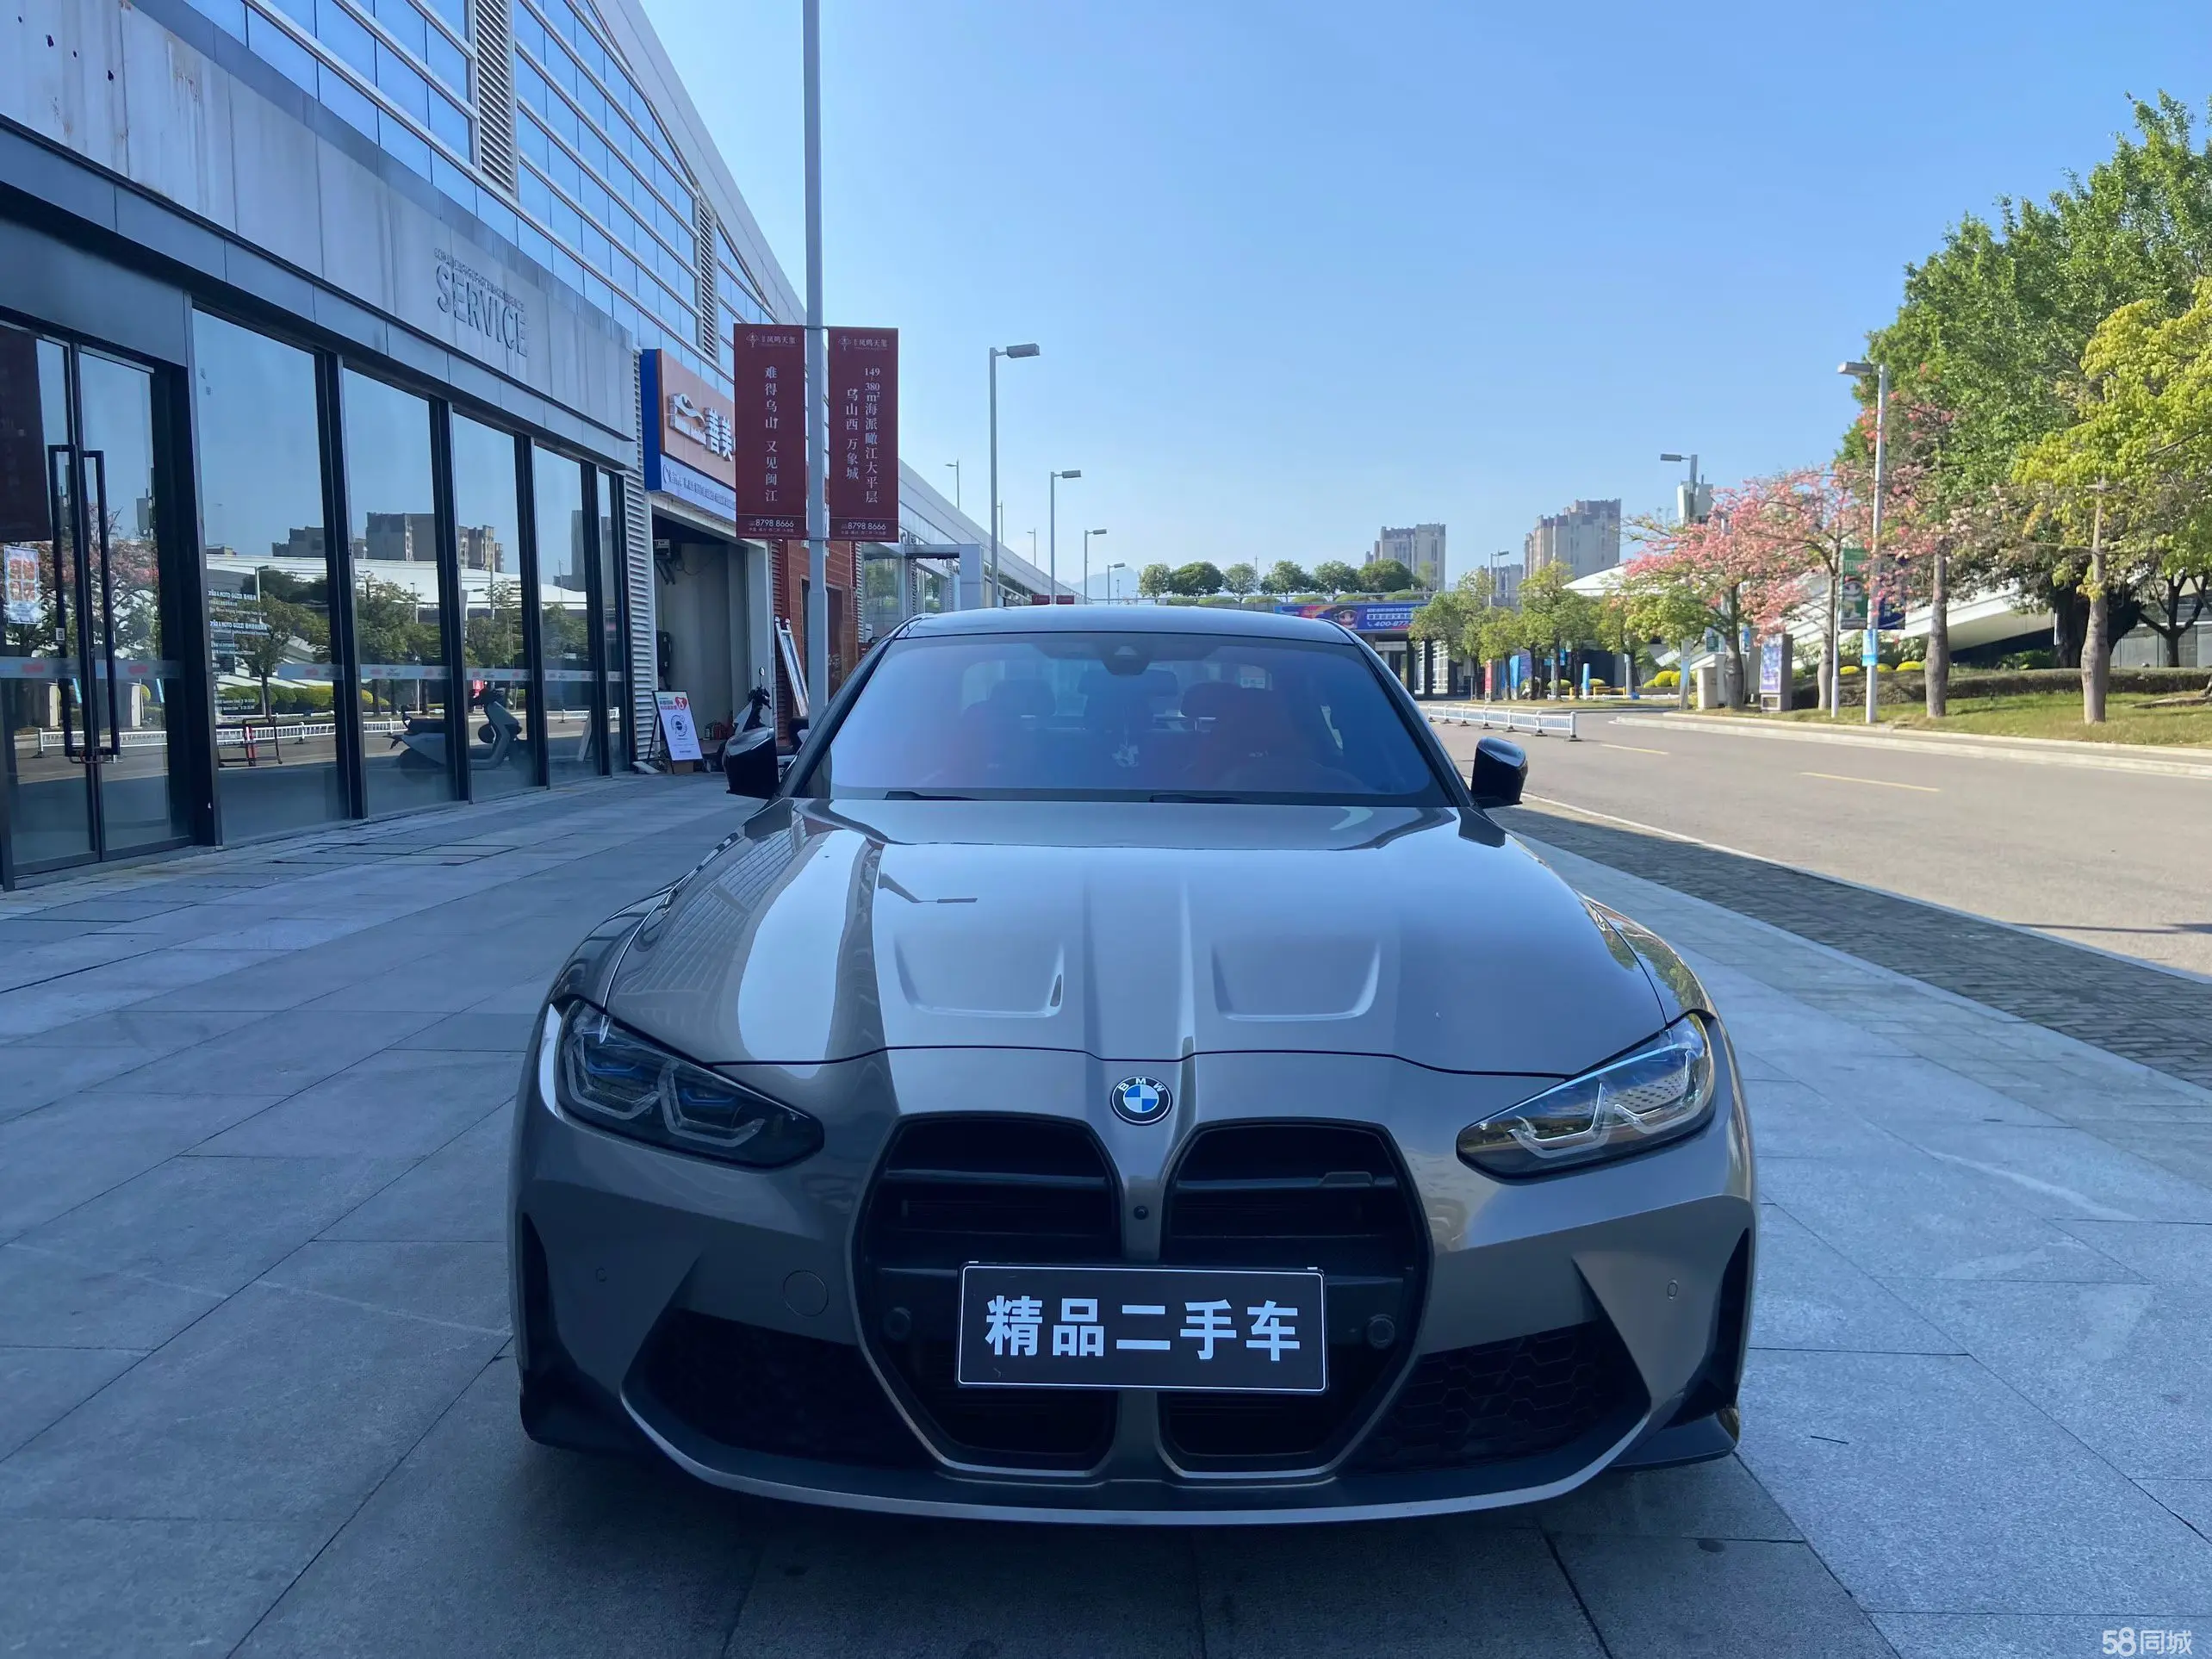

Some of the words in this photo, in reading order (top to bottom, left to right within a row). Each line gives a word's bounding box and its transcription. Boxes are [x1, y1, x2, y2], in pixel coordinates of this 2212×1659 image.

[436, 264, 528, 357] SERVICE
[865, 368, 880, 376] 149
[865, 382, 880, 391] 380
[765, 366, 779, 429] 难得乌山
[765, 440, 778, 502] 又见闽江
[846, 438, 859, 480] 万象城
[755, 519, 774, 527] 8798
[776, 519, 794, 528] 8666
[1118, 1078, 1165, 1092] BMW
[985, 1295, 1301, 1362] 精品二手车
